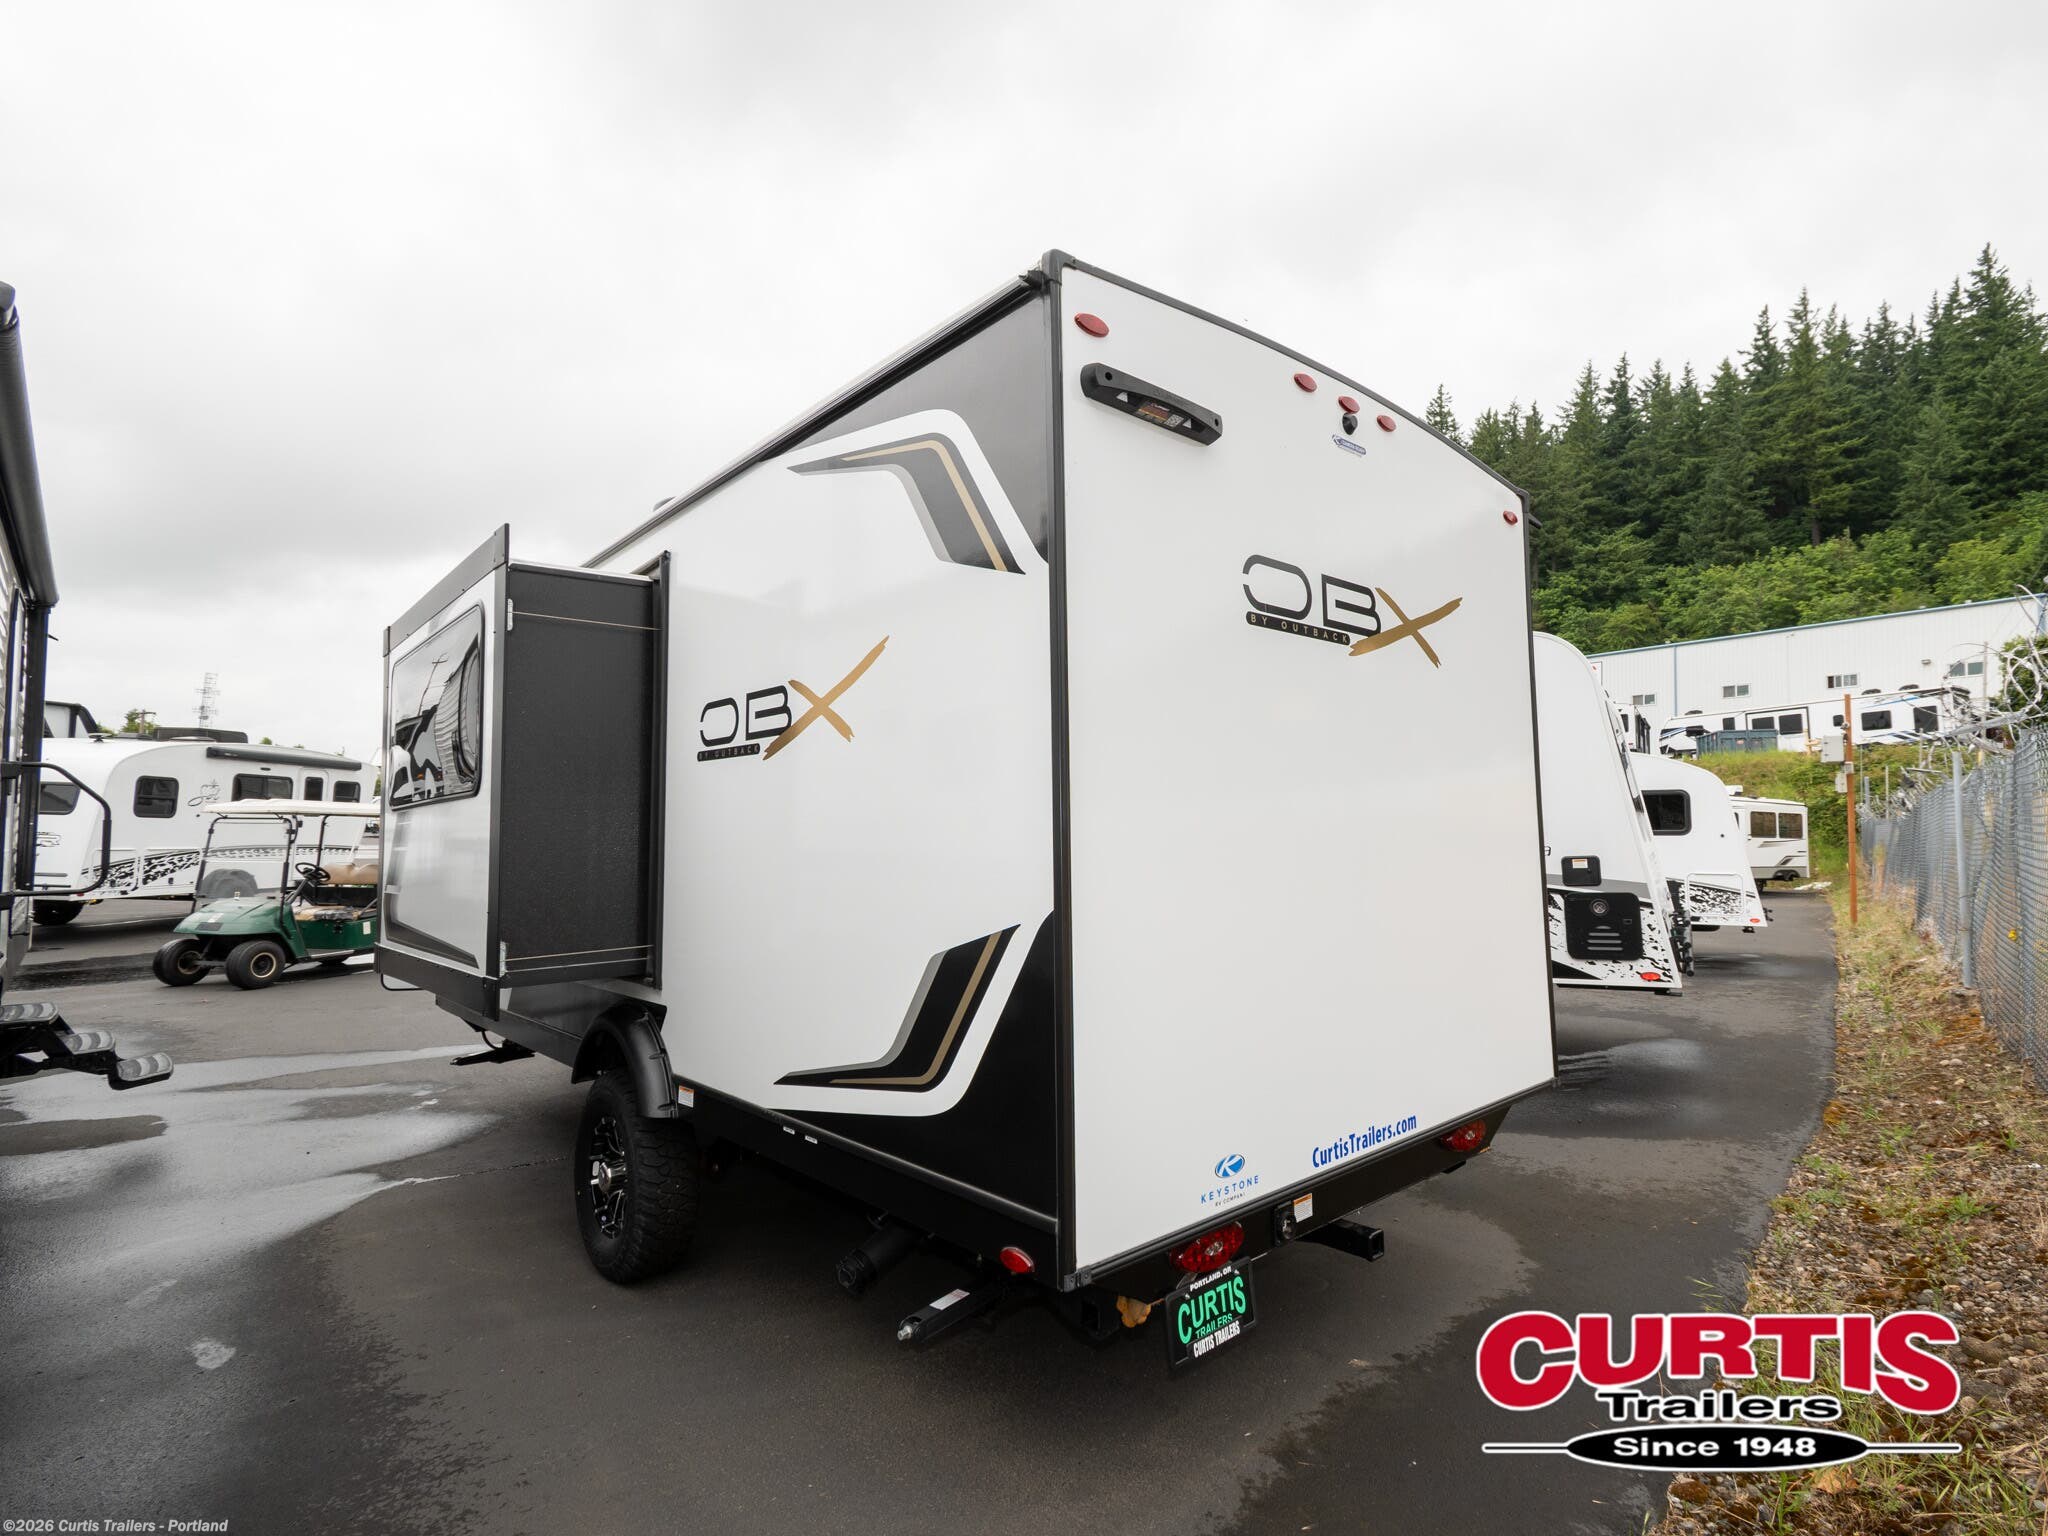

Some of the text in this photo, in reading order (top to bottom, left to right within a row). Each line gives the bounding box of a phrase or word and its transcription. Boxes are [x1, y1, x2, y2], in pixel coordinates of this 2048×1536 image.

[1242, 554, 1463, 669] OBX
[1250, 613, 1349, 644] BY OUTBACK
[700, 635, 890, 760] OBX
[714, 745, 759, 758] OUTBACK
[1312, 1115, 1417, 1168] CurtisTrailers.com
[1201, 1175, 1259, 1204] KEYSTONE
[1177, 1276, 1247, 1344] CURTIS
[1193, 1320, 1241, 1358] CURTIS TRAILERS
